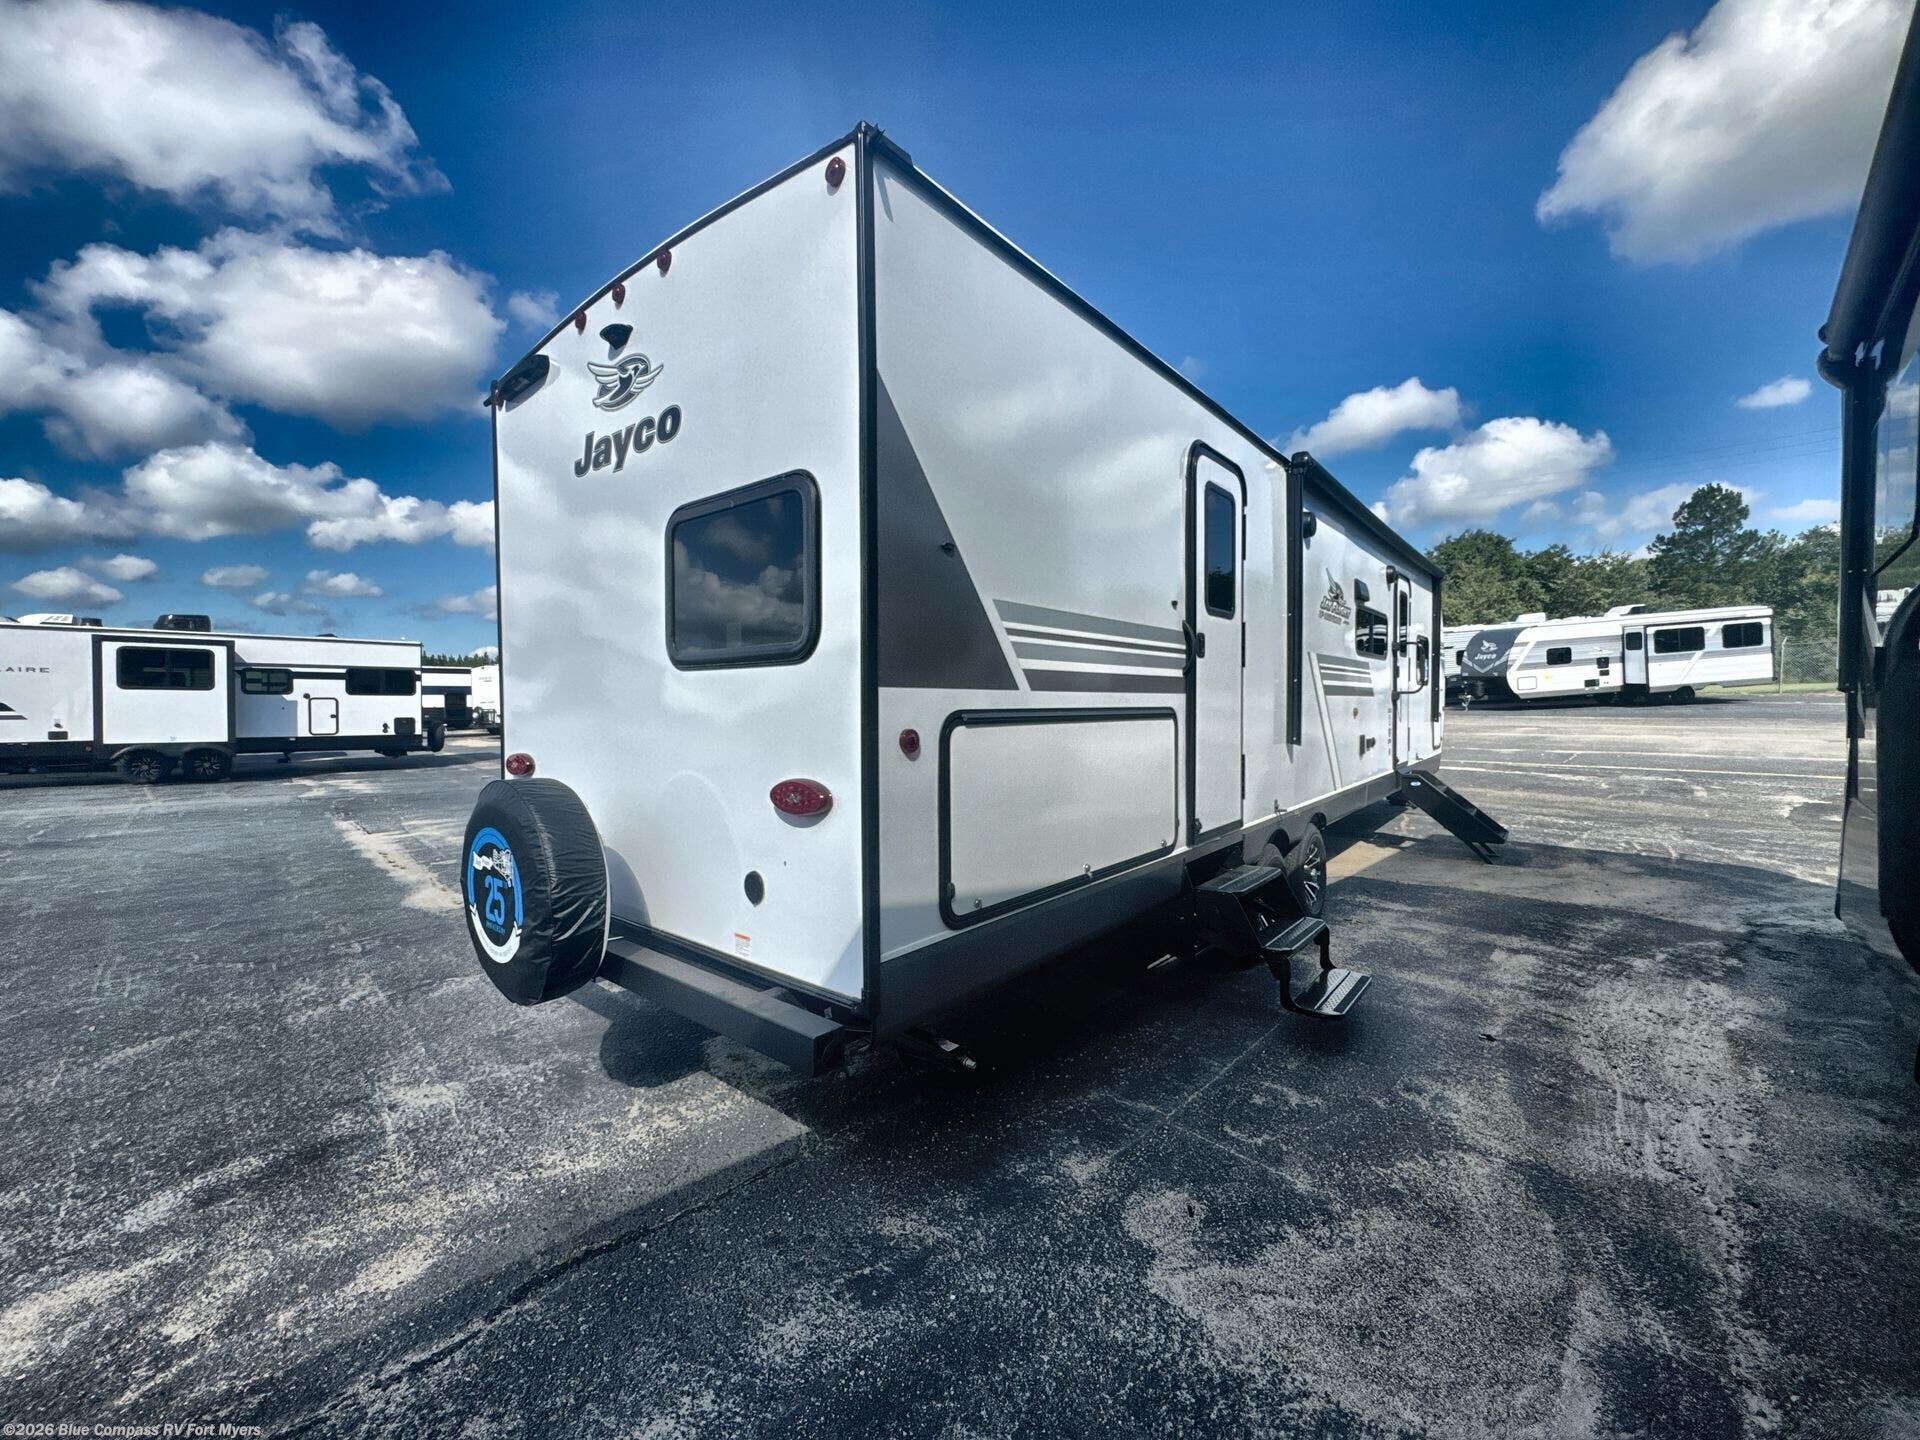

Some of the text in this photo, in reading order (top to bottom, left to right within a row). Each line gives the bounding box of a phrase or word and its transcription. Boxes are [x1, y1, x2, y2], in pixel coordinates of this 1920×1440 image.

[574, 404, 682, 478] Jayco
[1475, 653, 1497, 661] Jayco
[0, 666, 50, 674] AIRE
